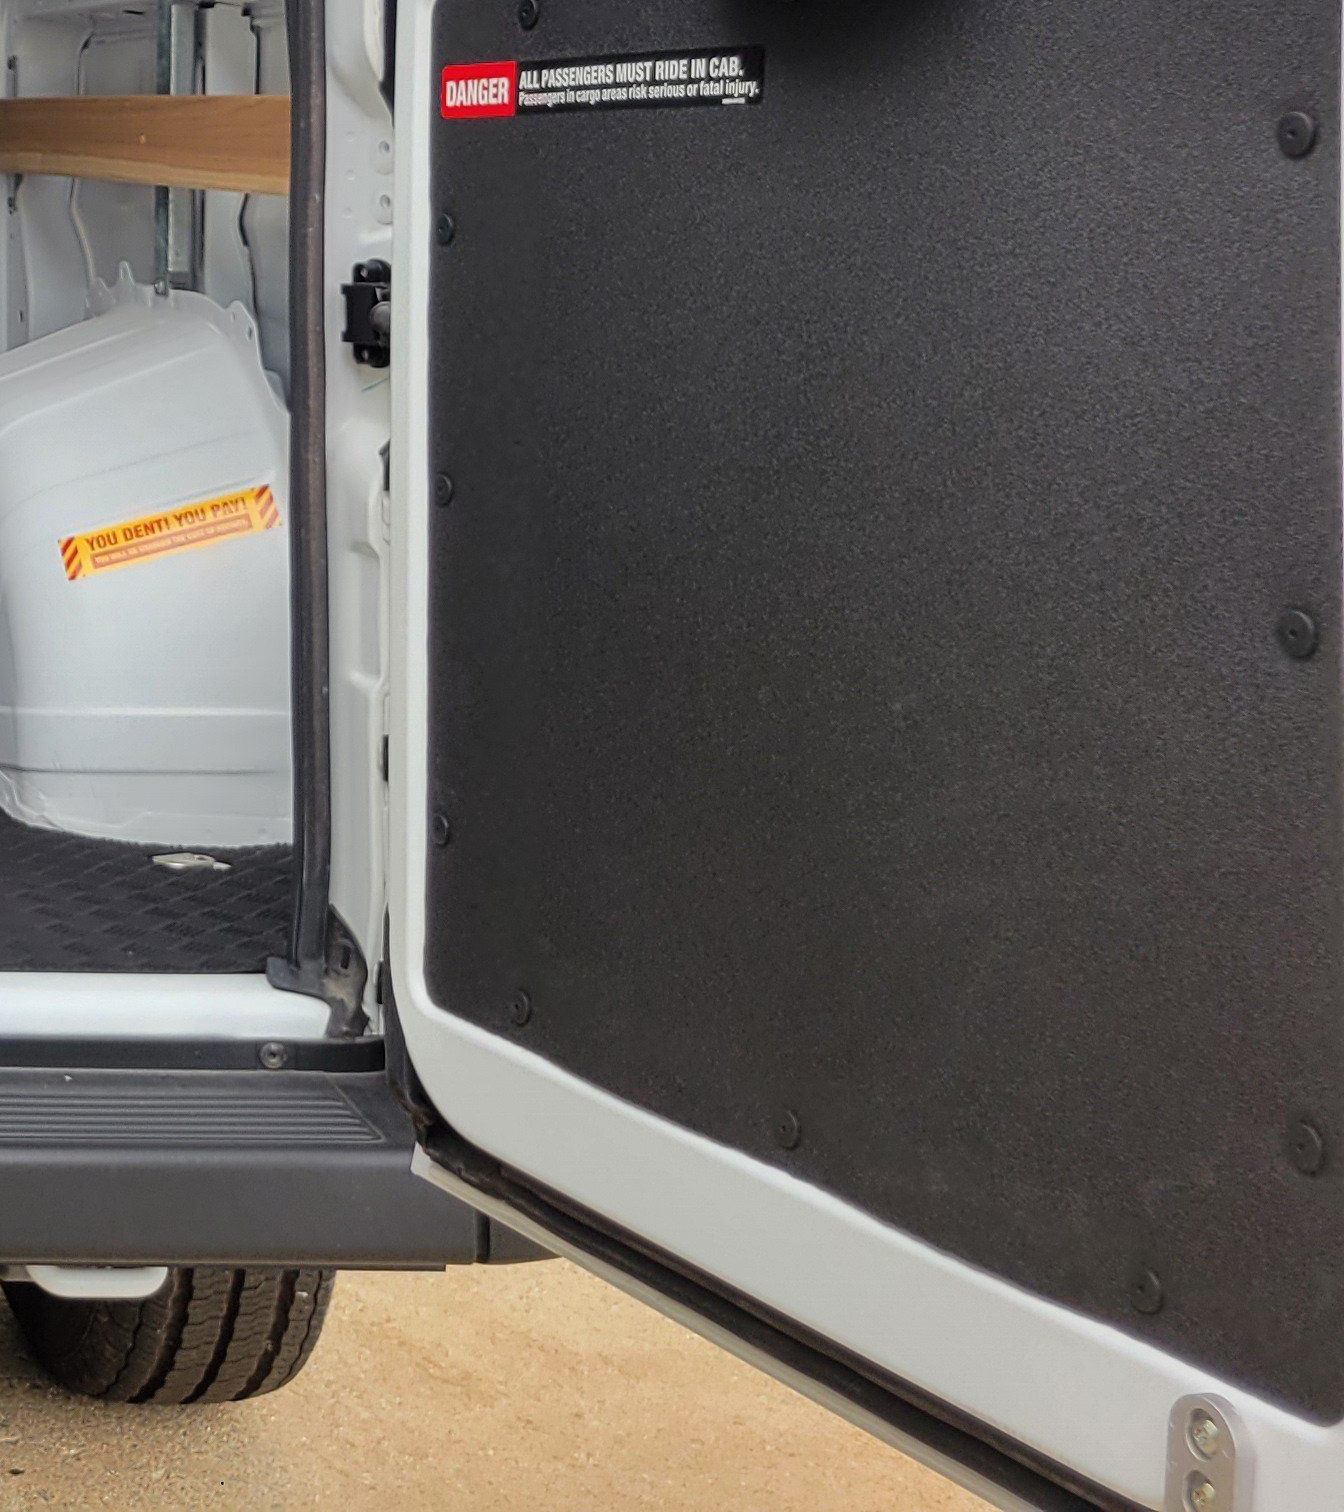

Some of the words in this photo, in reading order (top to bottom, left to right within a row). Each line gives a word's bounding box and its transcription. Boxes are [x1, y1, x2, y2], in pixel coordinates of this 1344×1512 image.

[518, 70, 540, 90] ALL
[541, 65, 614, 88] PASSENGERS
[616, 61, 653, 84] MUST
[655, 59, 688, 80] RIDE
[690, 57, 707, 78] IN
[708, 56, 743, 78] CAB.
[445, 77, 509, 108] DANGER
[518, 90, 566, 108] Passengers
[566, 89, 576, 102] in
[576, 88, 601, 105] cargo
[601, 87, 628, 101] areas
[628, 84, 647, 99] risk
[648, 83, 686, 98] serious
[686, 84, 698, 97] or
[699, 80, 724, 96] fatal
[725, 79, 760, 98] injury.
[85, 532, 118, 552] YOU
[123, 517, 171, 542] DENT!
[174, 507, 206, 527] YOU
[211, 496, 249, 519] PAY!
